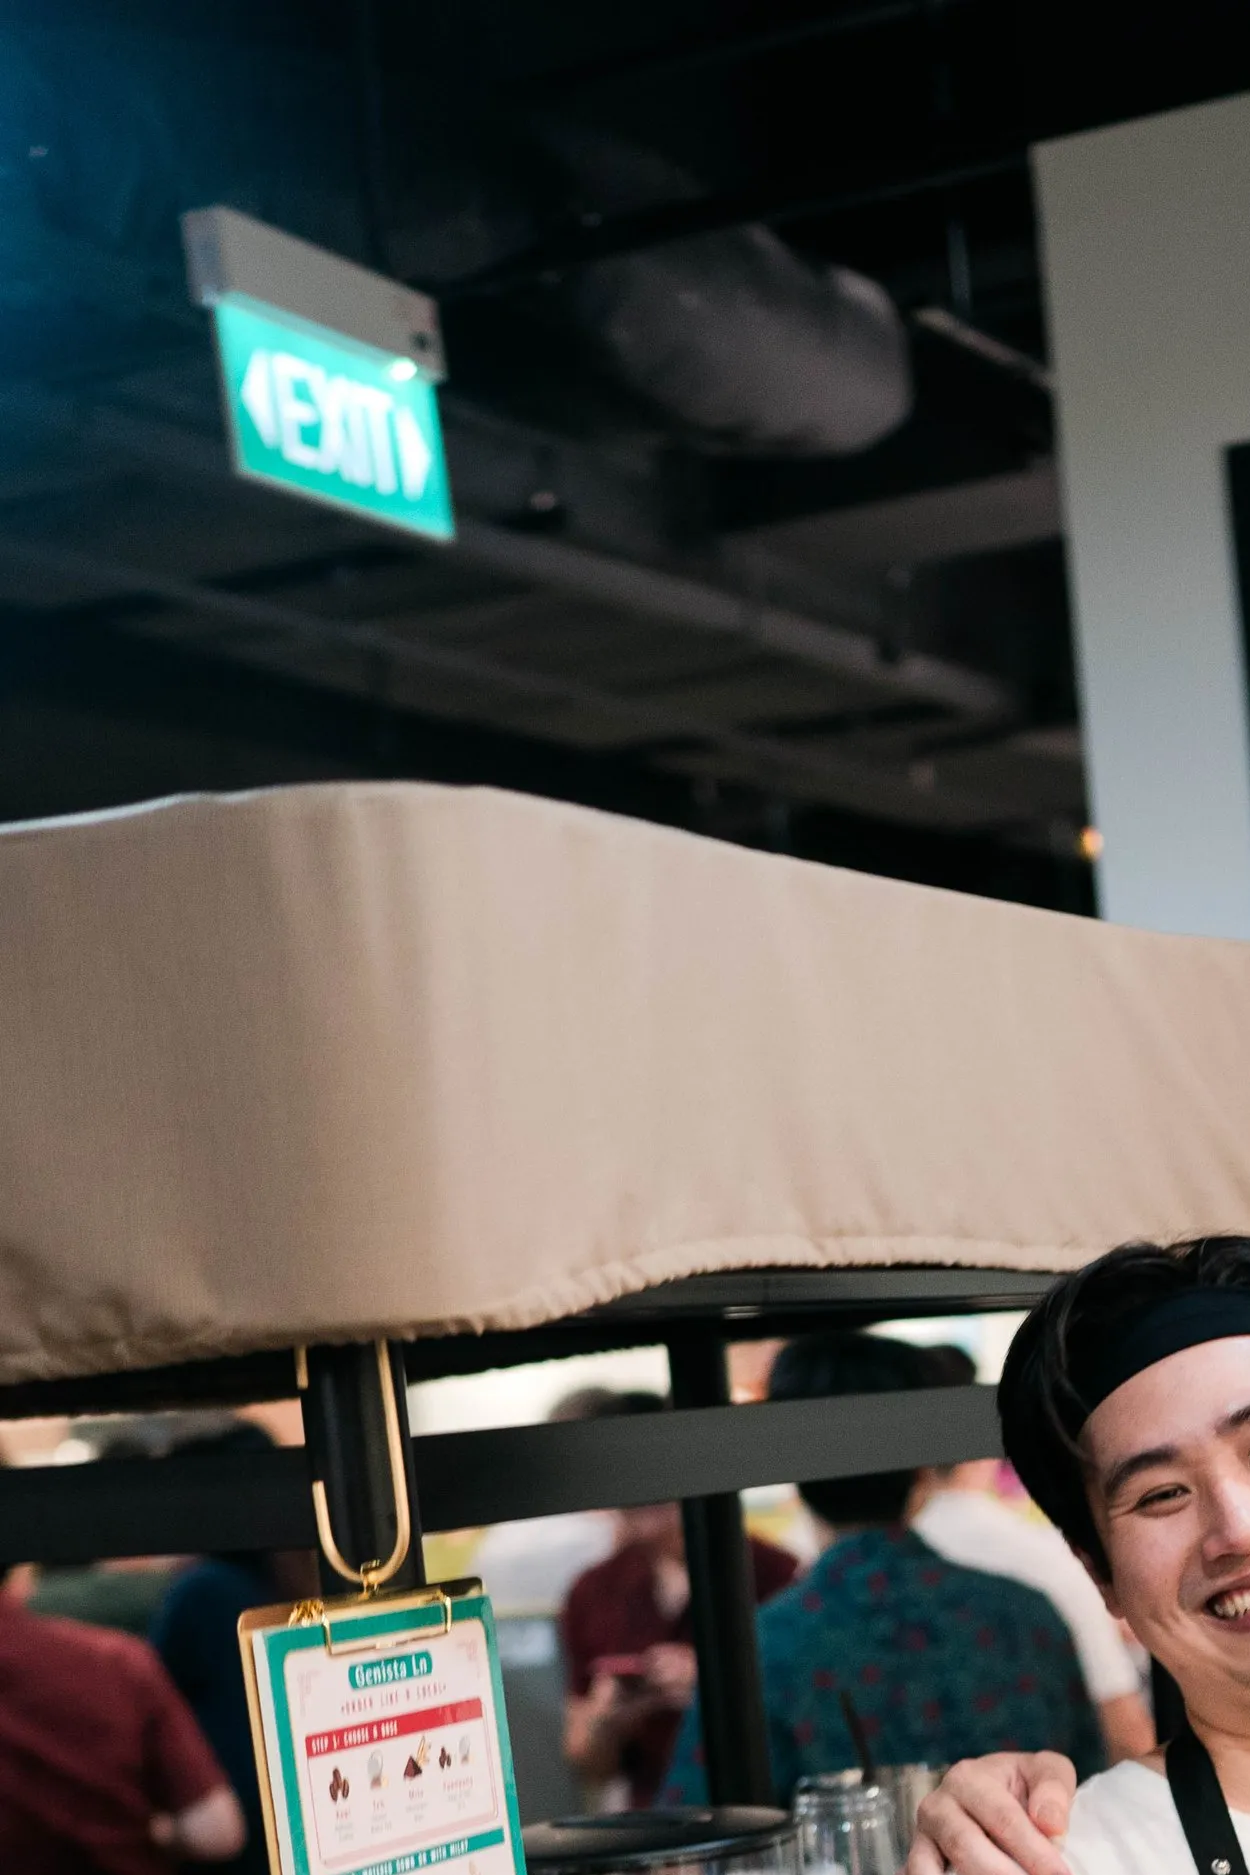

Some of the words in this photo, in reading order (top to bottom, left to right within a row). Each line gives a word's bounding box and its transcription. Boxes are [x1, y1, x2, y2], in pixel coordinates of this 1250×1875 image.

[272, 352, 398, 496] EXIT
[355, 1659, 407, 1688] Genista
[412, 1653, 428, 1675] Ln
